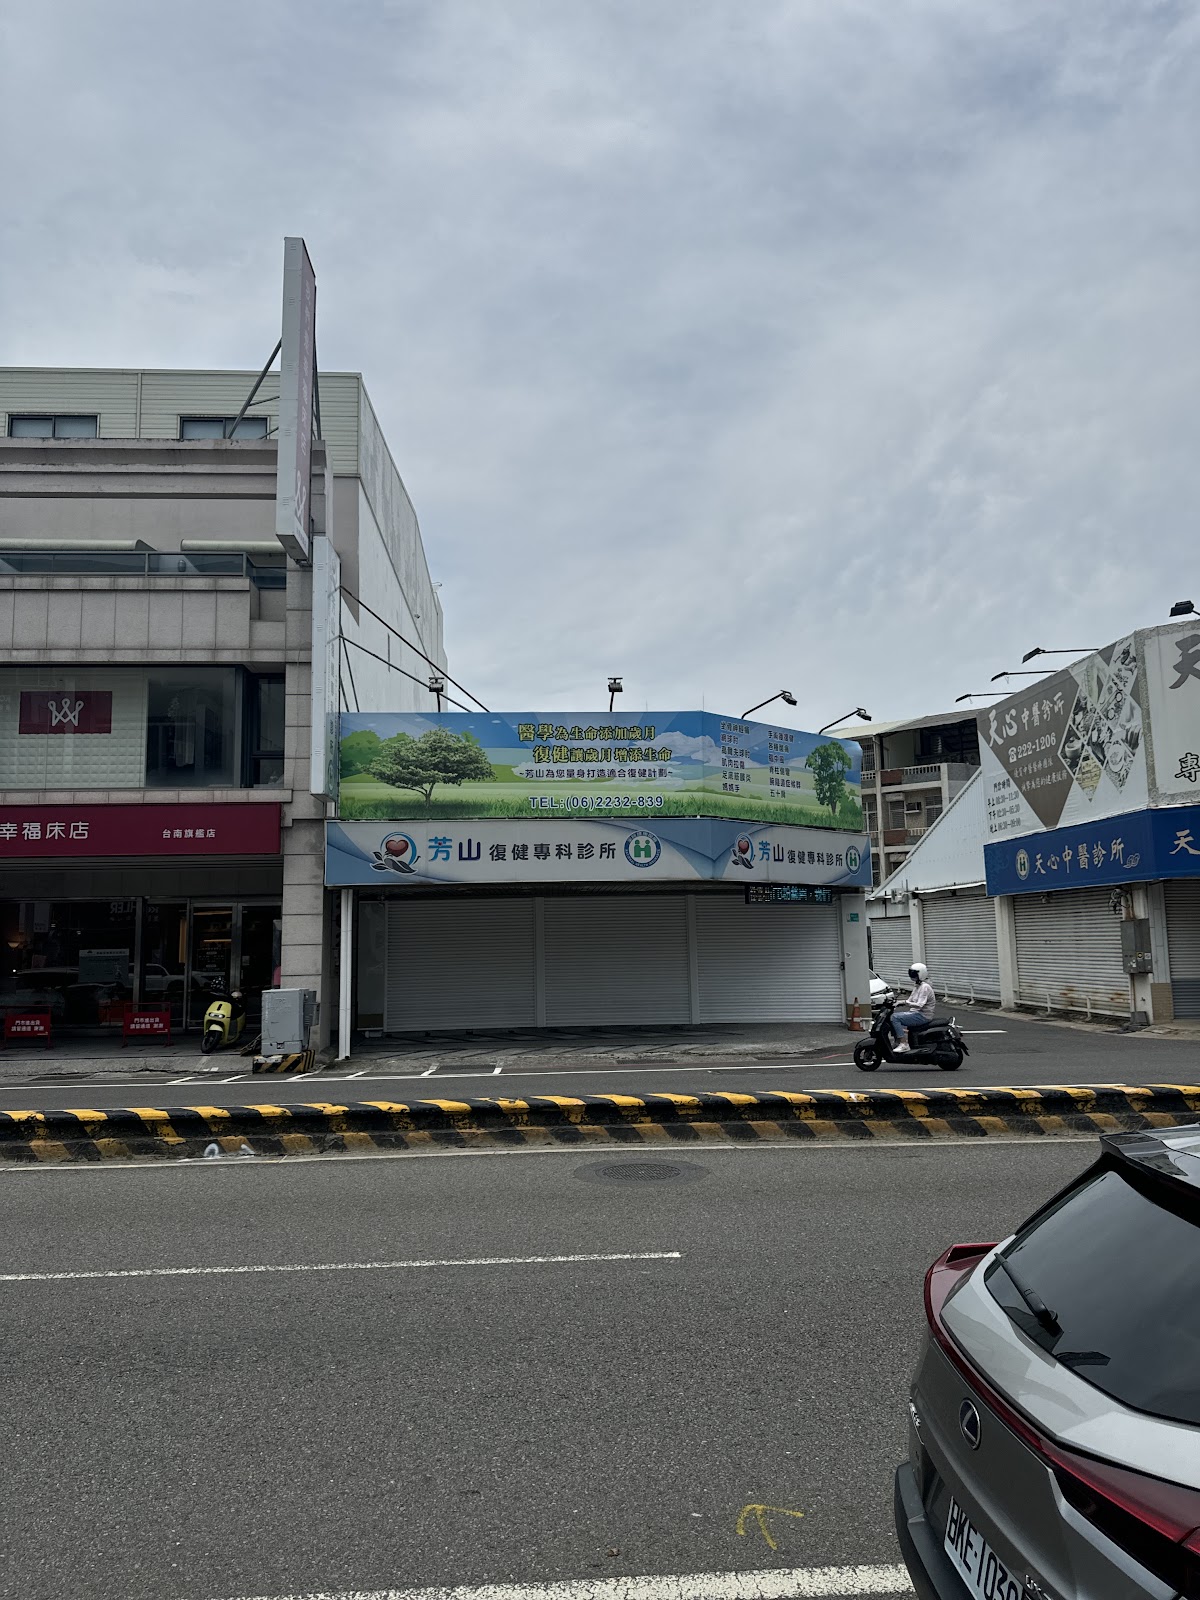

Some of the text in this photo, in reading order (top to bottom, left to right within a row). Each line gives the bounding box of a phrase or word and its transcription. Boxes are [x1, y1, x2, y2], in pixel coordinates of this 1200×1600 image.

[988, 691, 1065, 748] 天心中醫診所
[518, 723, 656, 742] 醫學為生命添加歲月
[533, 746, 673, 764] 復健讓歲月增添生命
[1017, 732, 1056, 759] 222-1206
[529, 795, 664, 810] TEL:(06)2232-839
[0, 821, 89, 840] 幸福床店
[162, 828, 216, 839] 台南旗艦店
[1033, 837, 1125, 875] 天心中醫診所
